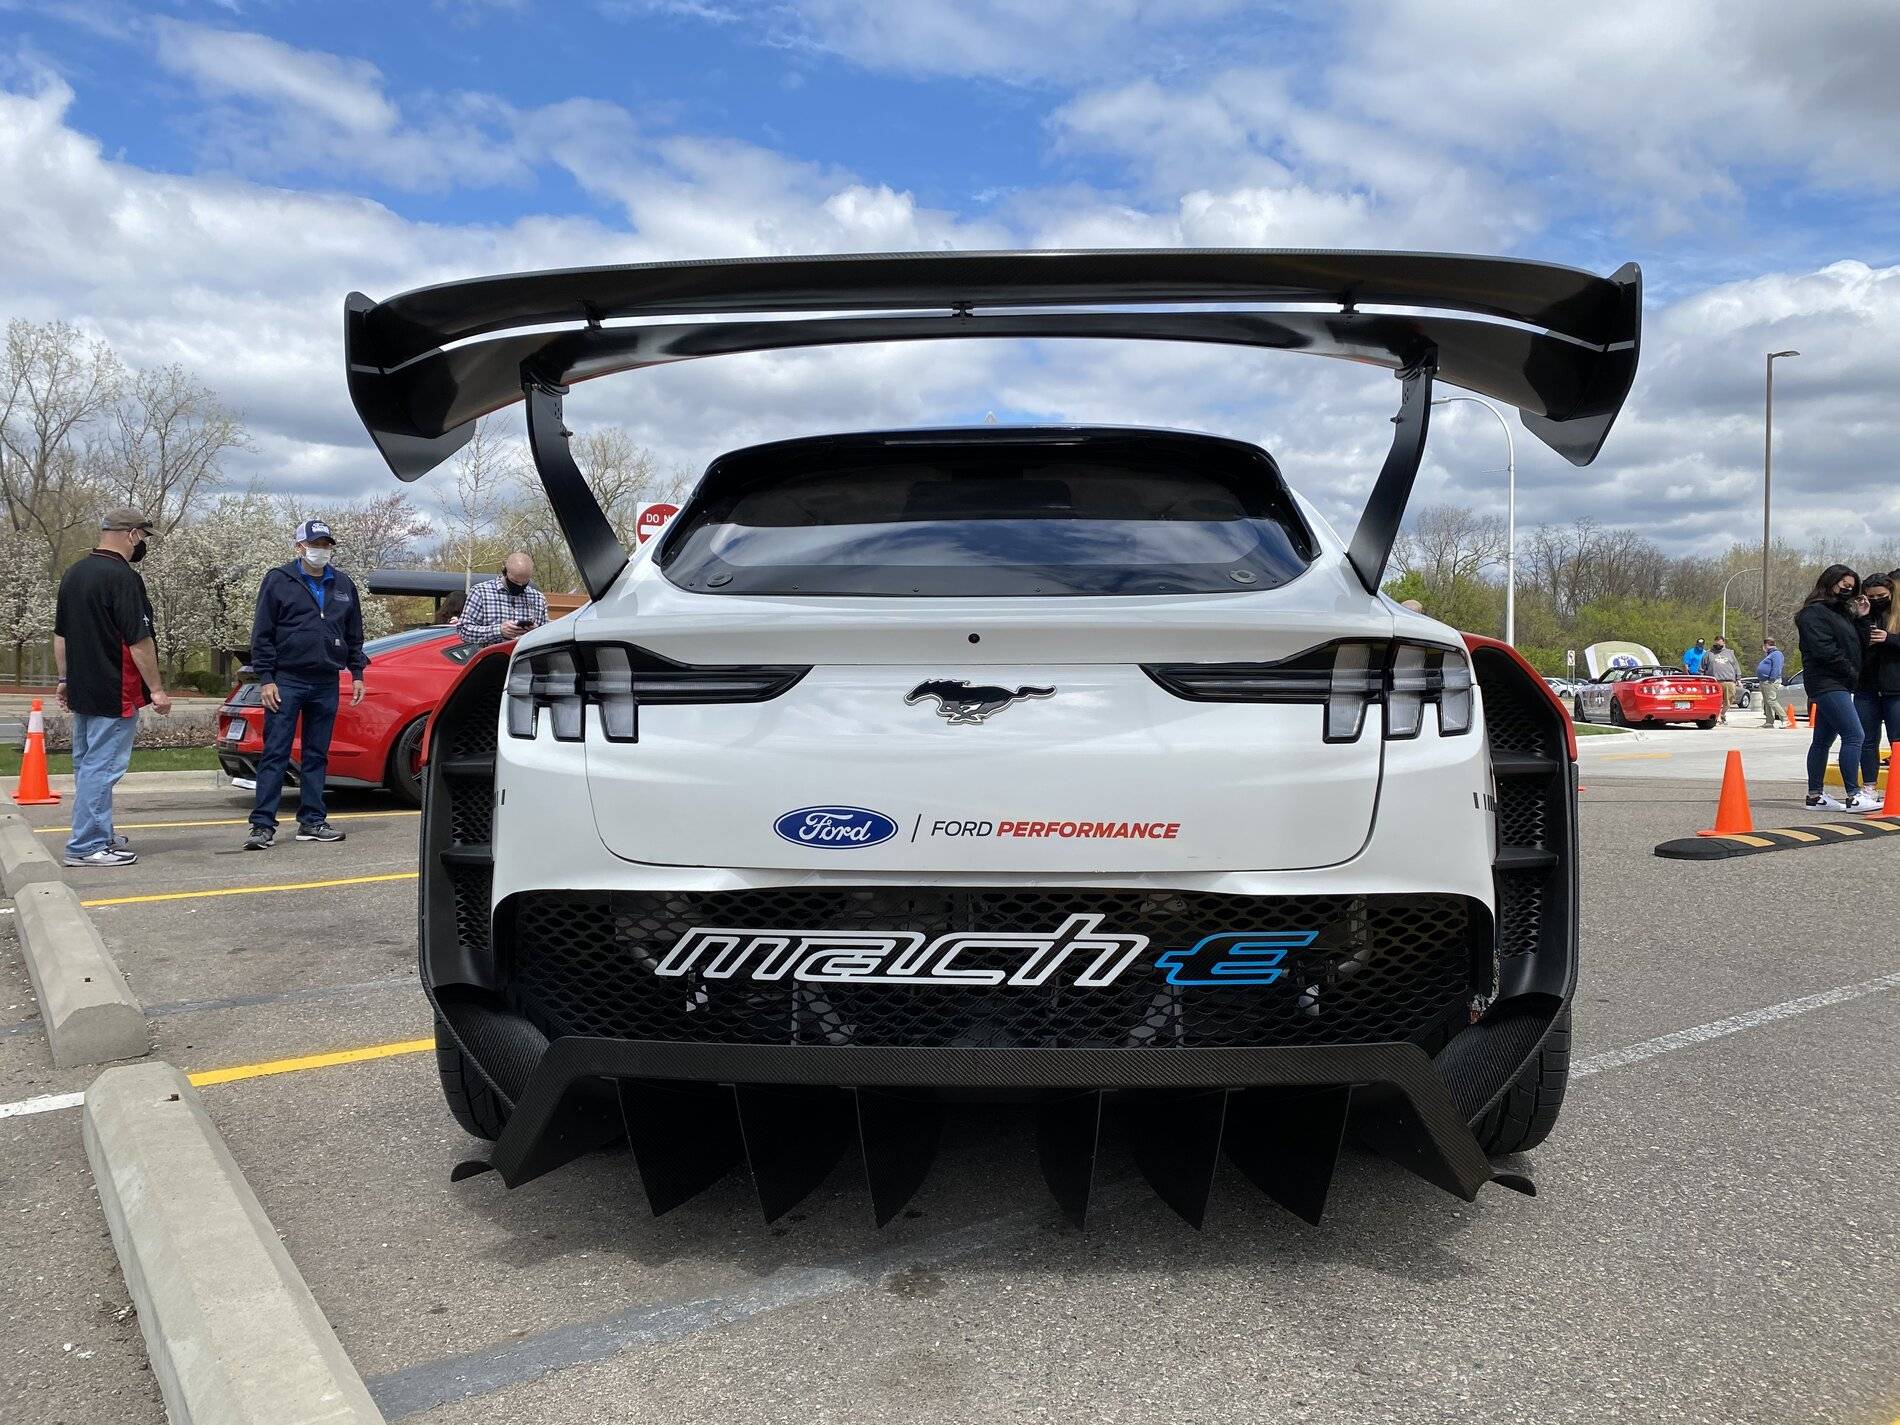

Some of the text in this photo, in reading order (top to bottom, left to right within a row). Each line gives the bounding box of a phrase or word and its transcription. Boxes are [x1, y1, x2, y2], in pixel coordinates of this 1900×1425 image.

[646, 513, 660, 523] DO
[799, 811, 873, 841] Ford
[931, 820, 1181, 839] FORD PERFORMANCE
